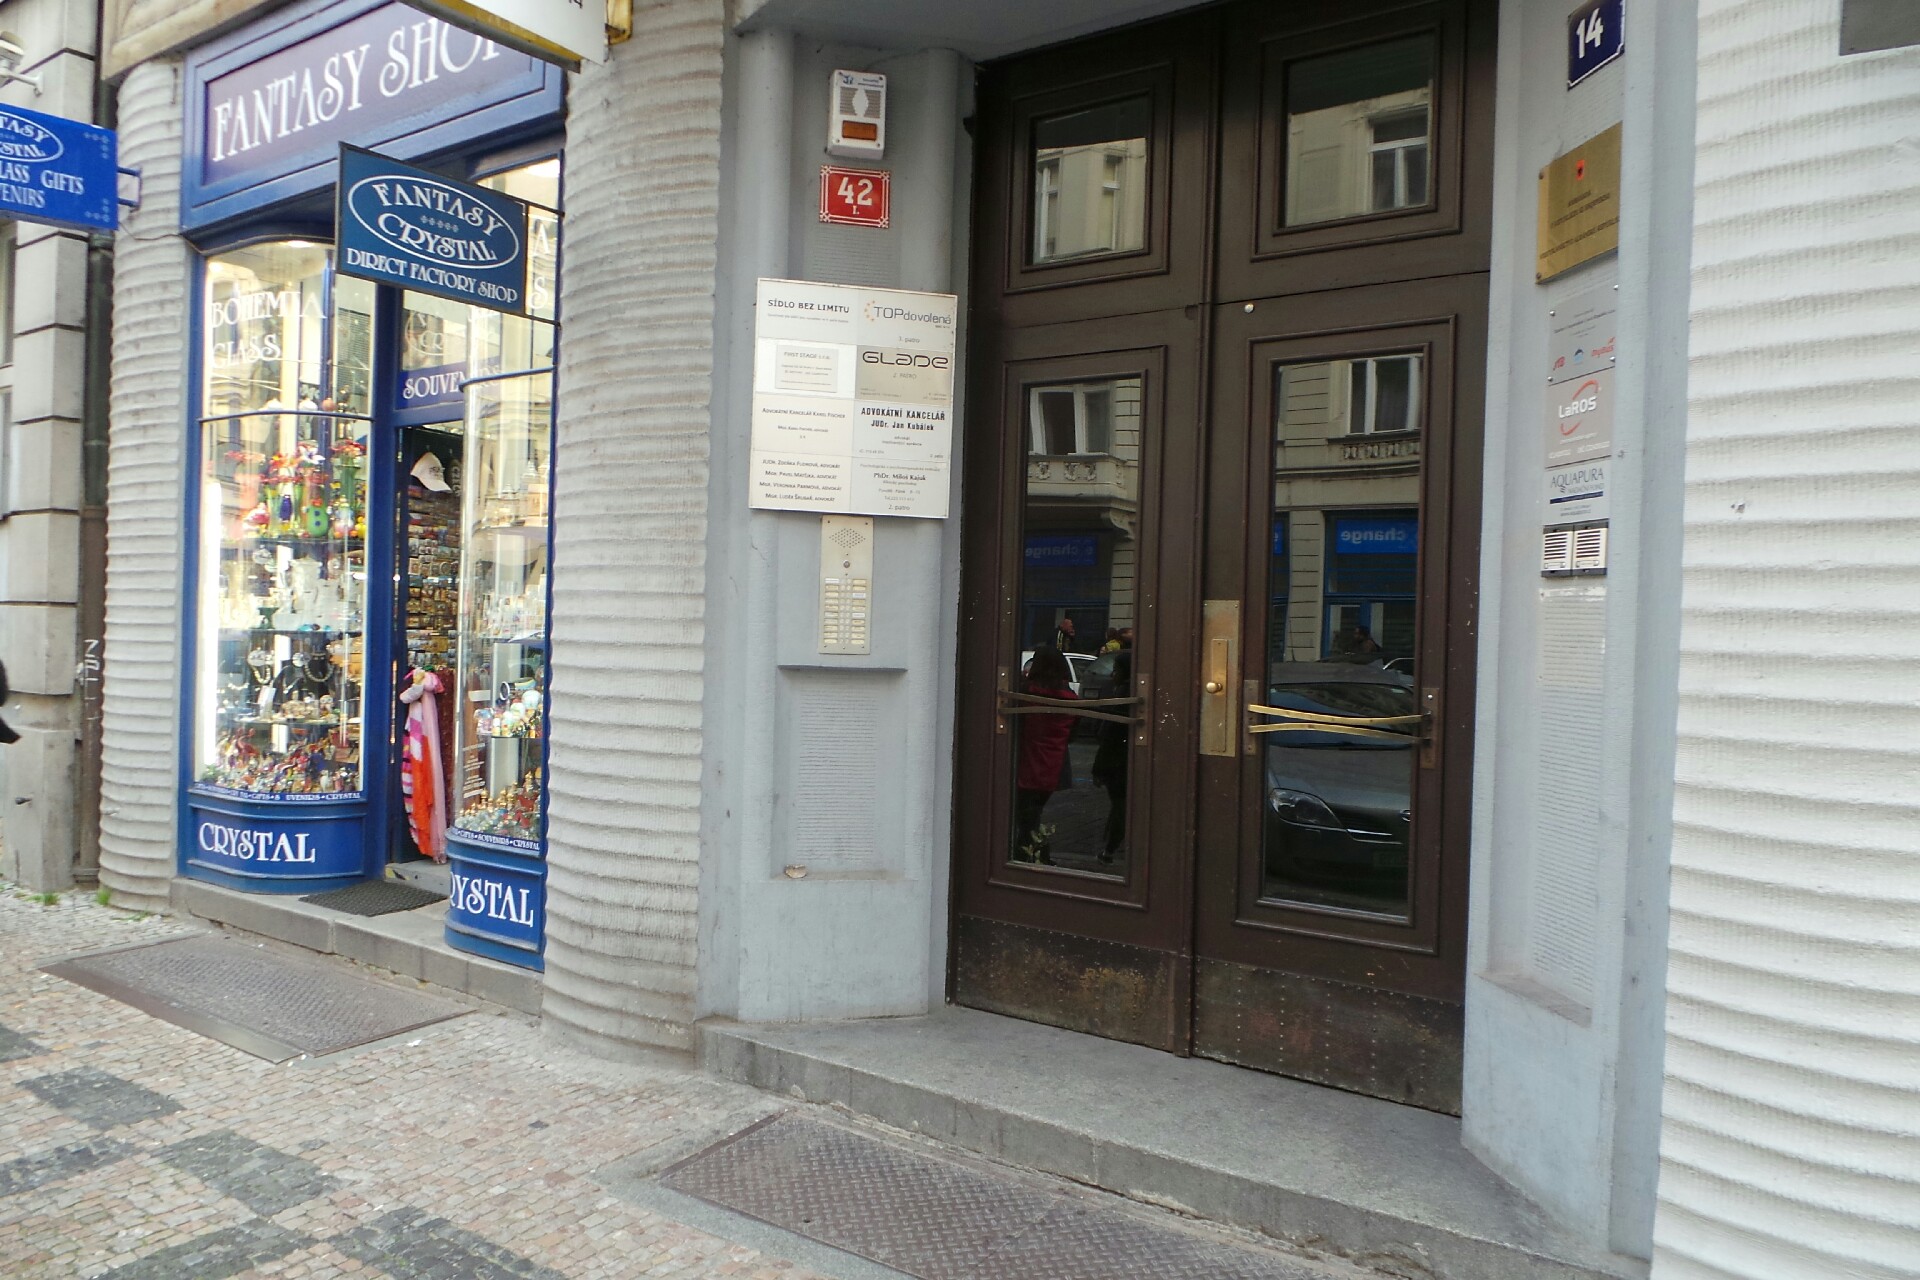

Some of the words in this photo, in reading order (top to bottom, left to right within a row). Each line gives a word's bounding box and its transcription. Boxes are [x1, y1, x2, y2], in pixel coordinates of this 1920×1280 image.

[1576, 8, 1603, 58] 14
[212, 44, 370, 162] FANTASY
[41, 169, 84, 195] GIFTS
[838, 176, 873, 206] 42
[372, 182, 503, 236] FANTASY
[378, 212, 498, 261] CRYSTAL
[346, 248, 407, 276] DIRECT
[409, 262, 477, 293] FACTORY
[477, 281, 518, 303] SHOP
[212, 291, 328, 329] BOHEMIA
[768, 298, 795, 308] SÍDLO
[798, 302, 815, 310] BEZ
[817, 304, 850, 313] LIMITU
[873, 306, 952, 324] TOPdovolená
[212, 333, 281, 368] GLASS
[861, 407, 902, 418] ADVOKÁTNÍ
[906, 410, 946, 420] KANCELÁŘ
[1558, 395, 1598, 419] LaROS
[871, 420, 890, 428] JUDr.
[1551, 467, 1604, 489] AQUAPURA
[200, 822, 316, 864] CRYSTAL
